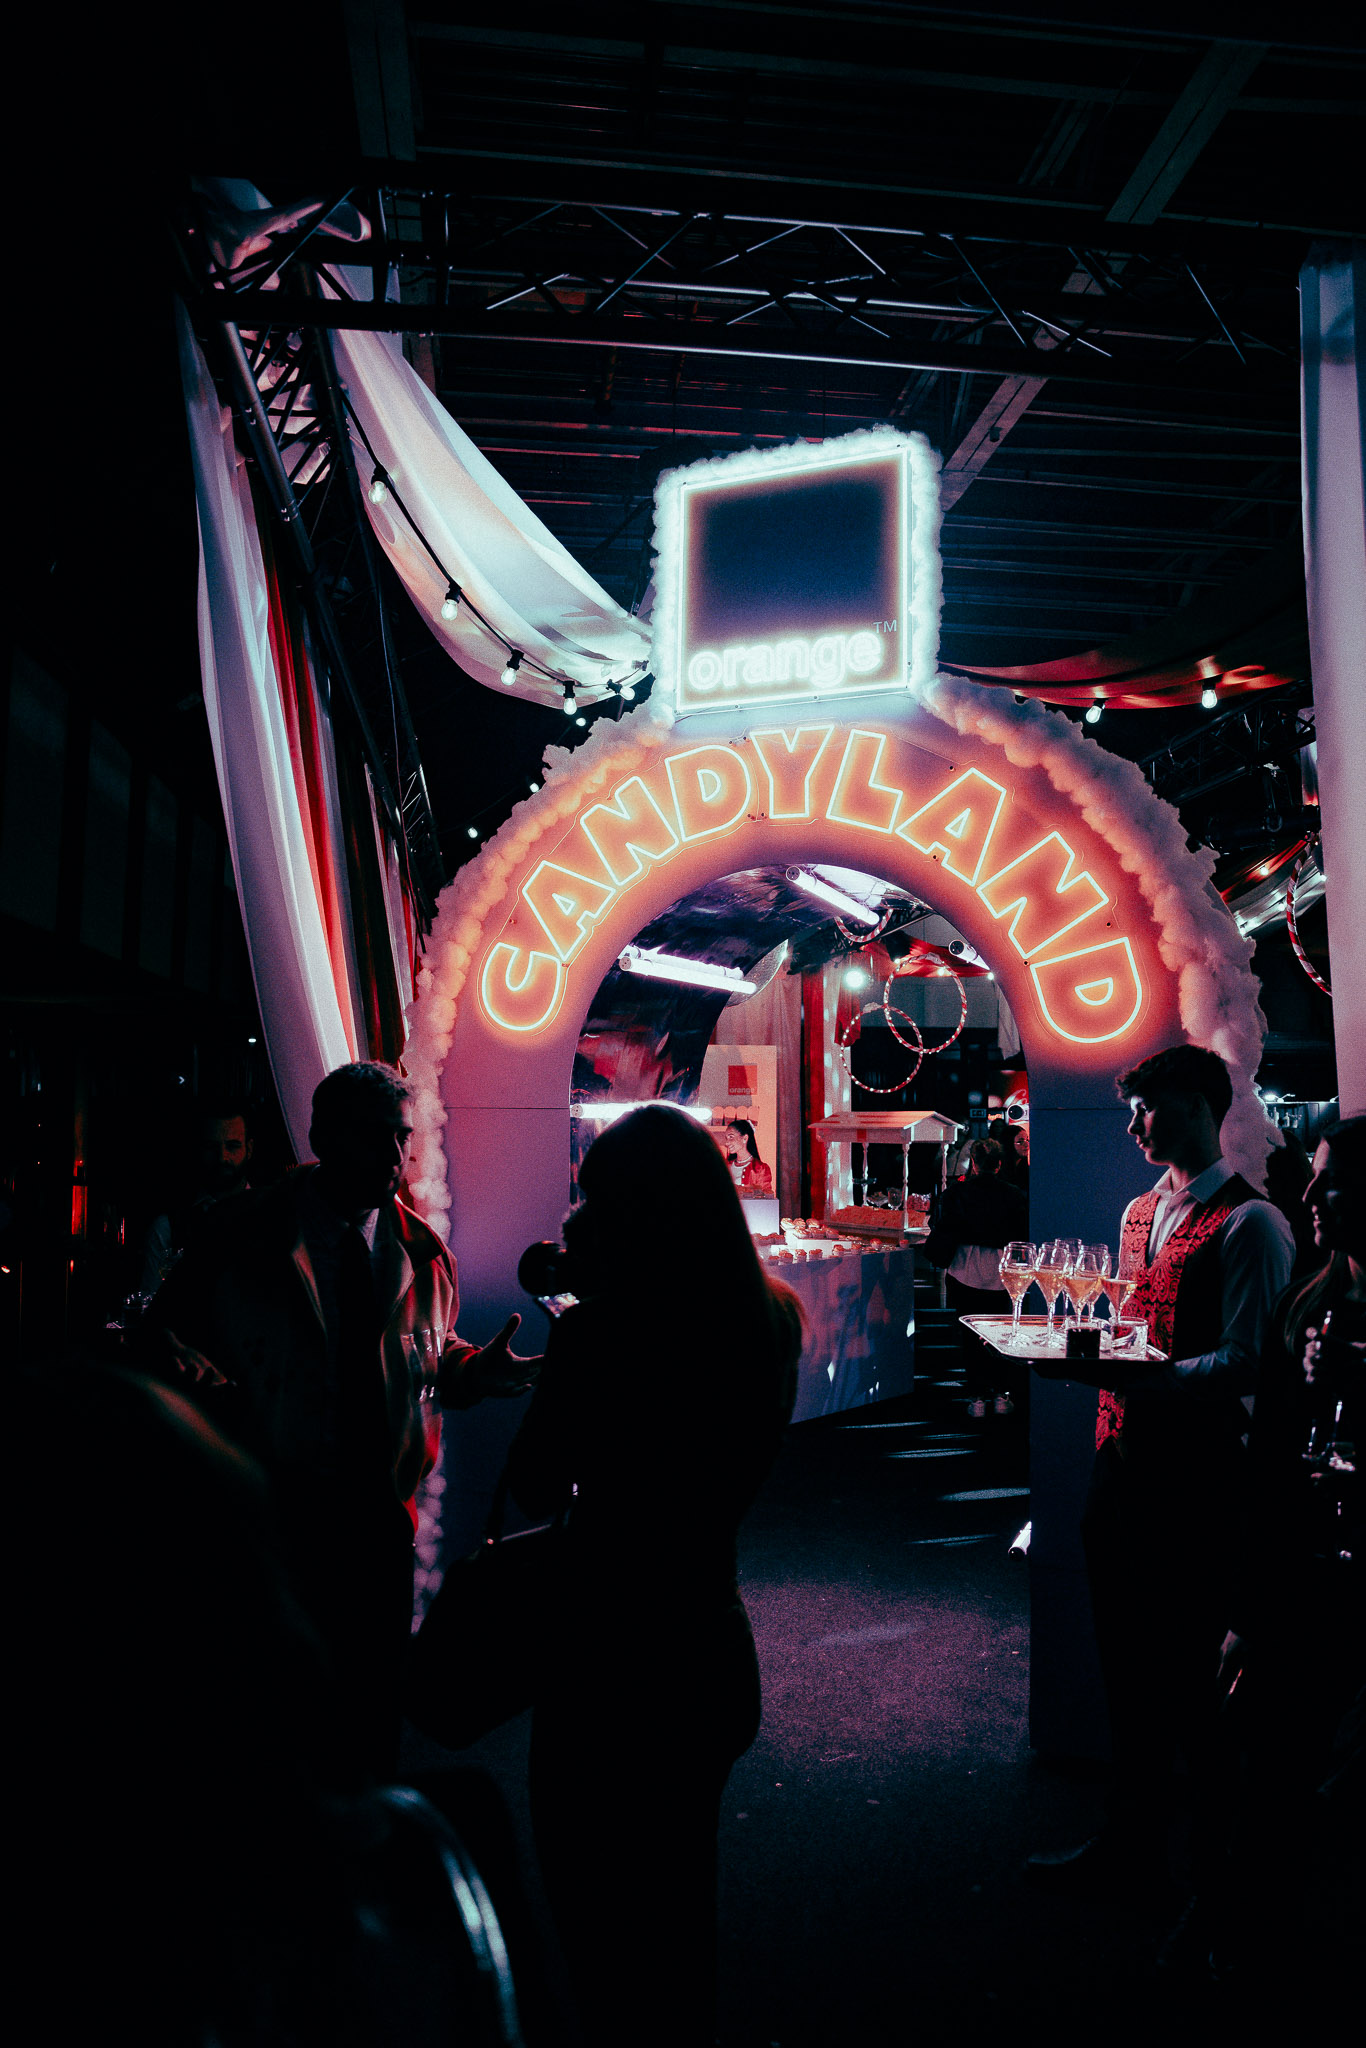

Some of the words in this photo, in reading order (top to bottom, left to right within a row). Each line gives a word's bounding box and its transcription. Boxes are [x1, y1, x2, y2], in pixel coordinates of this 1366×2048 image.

[688, 631, 882, 690] orange
[873, 619, 897, 634] TM
[481, 726, 1143, 1043] CANDYLAND
[729, 1087, 755, 1095] orange
